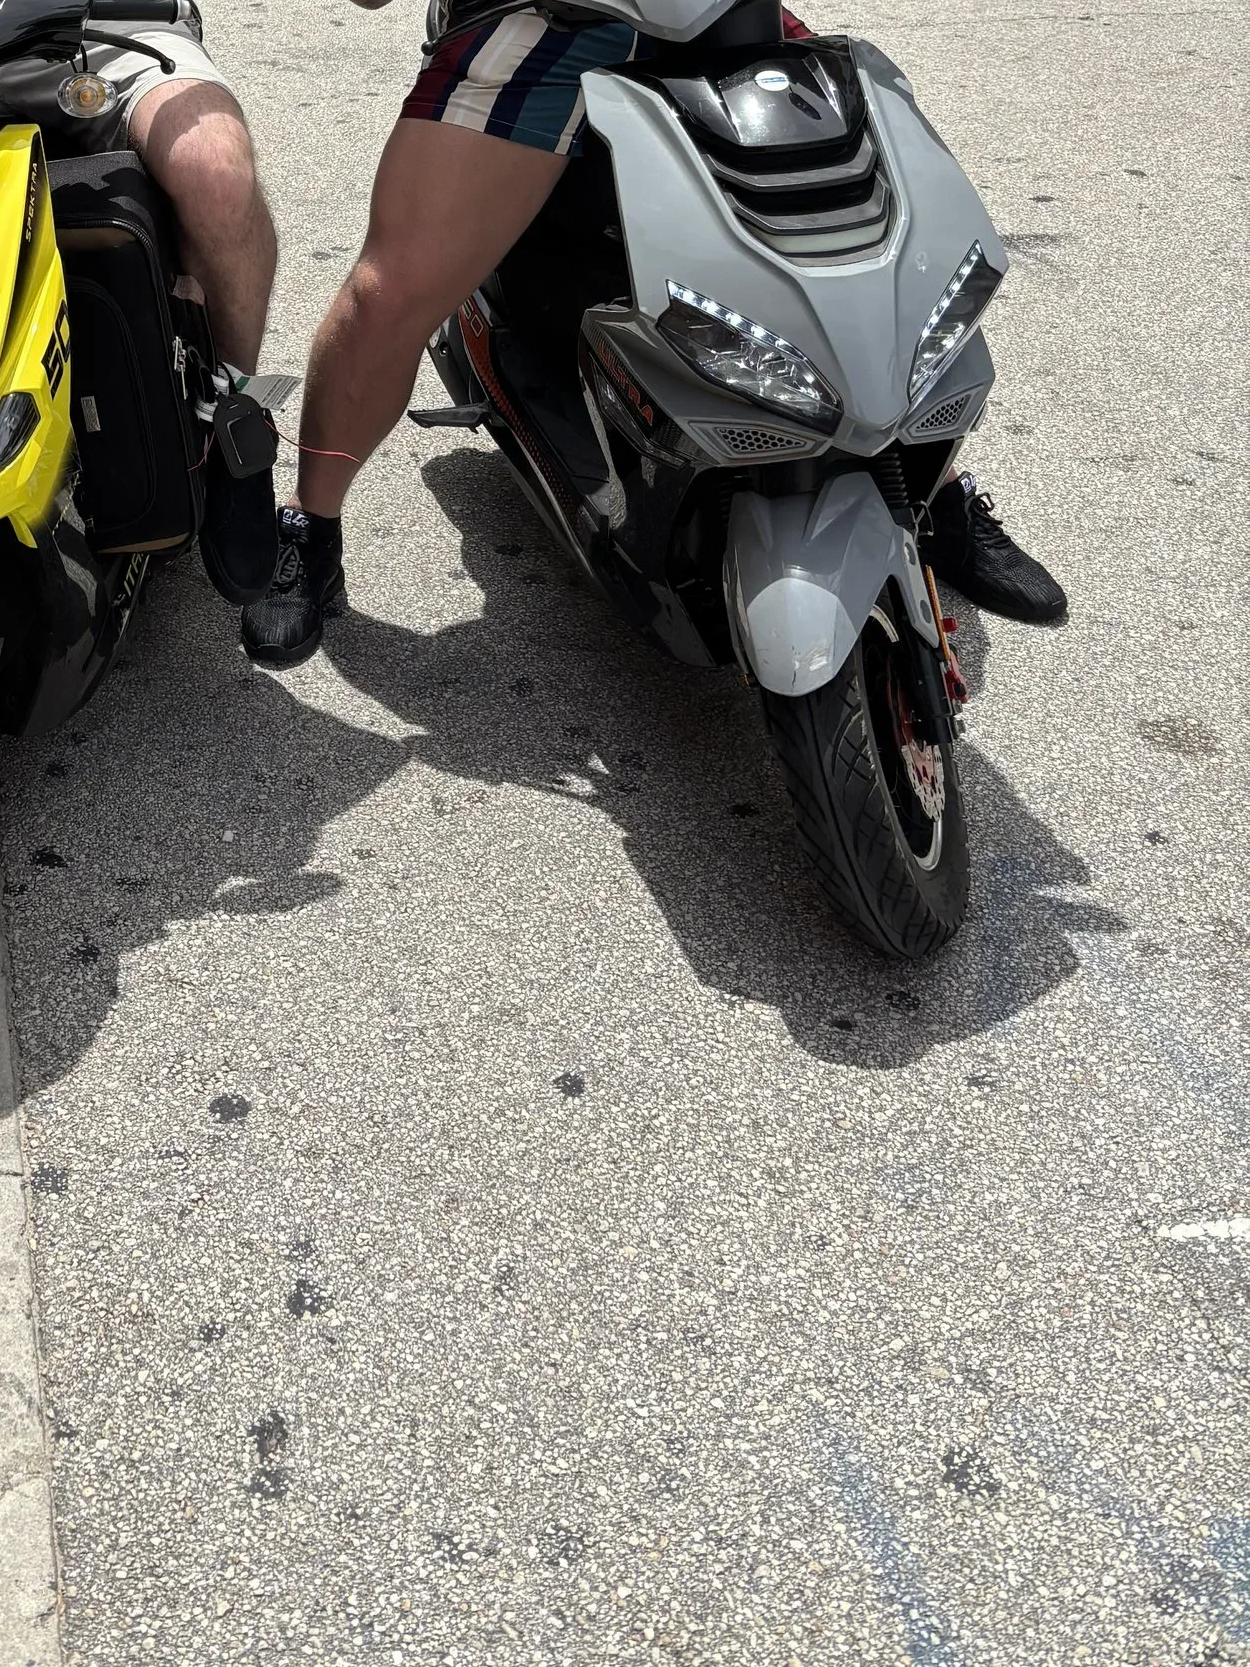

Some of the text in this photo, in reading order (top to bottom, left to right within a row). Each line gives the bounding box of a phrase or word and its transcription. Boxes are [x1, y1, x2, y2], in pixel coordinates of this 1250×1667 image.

[26, 163, 38, 243] SPEKTRA
[40, 299, 70, 402] 50
[598, 340, 654, 427] ULTRA
